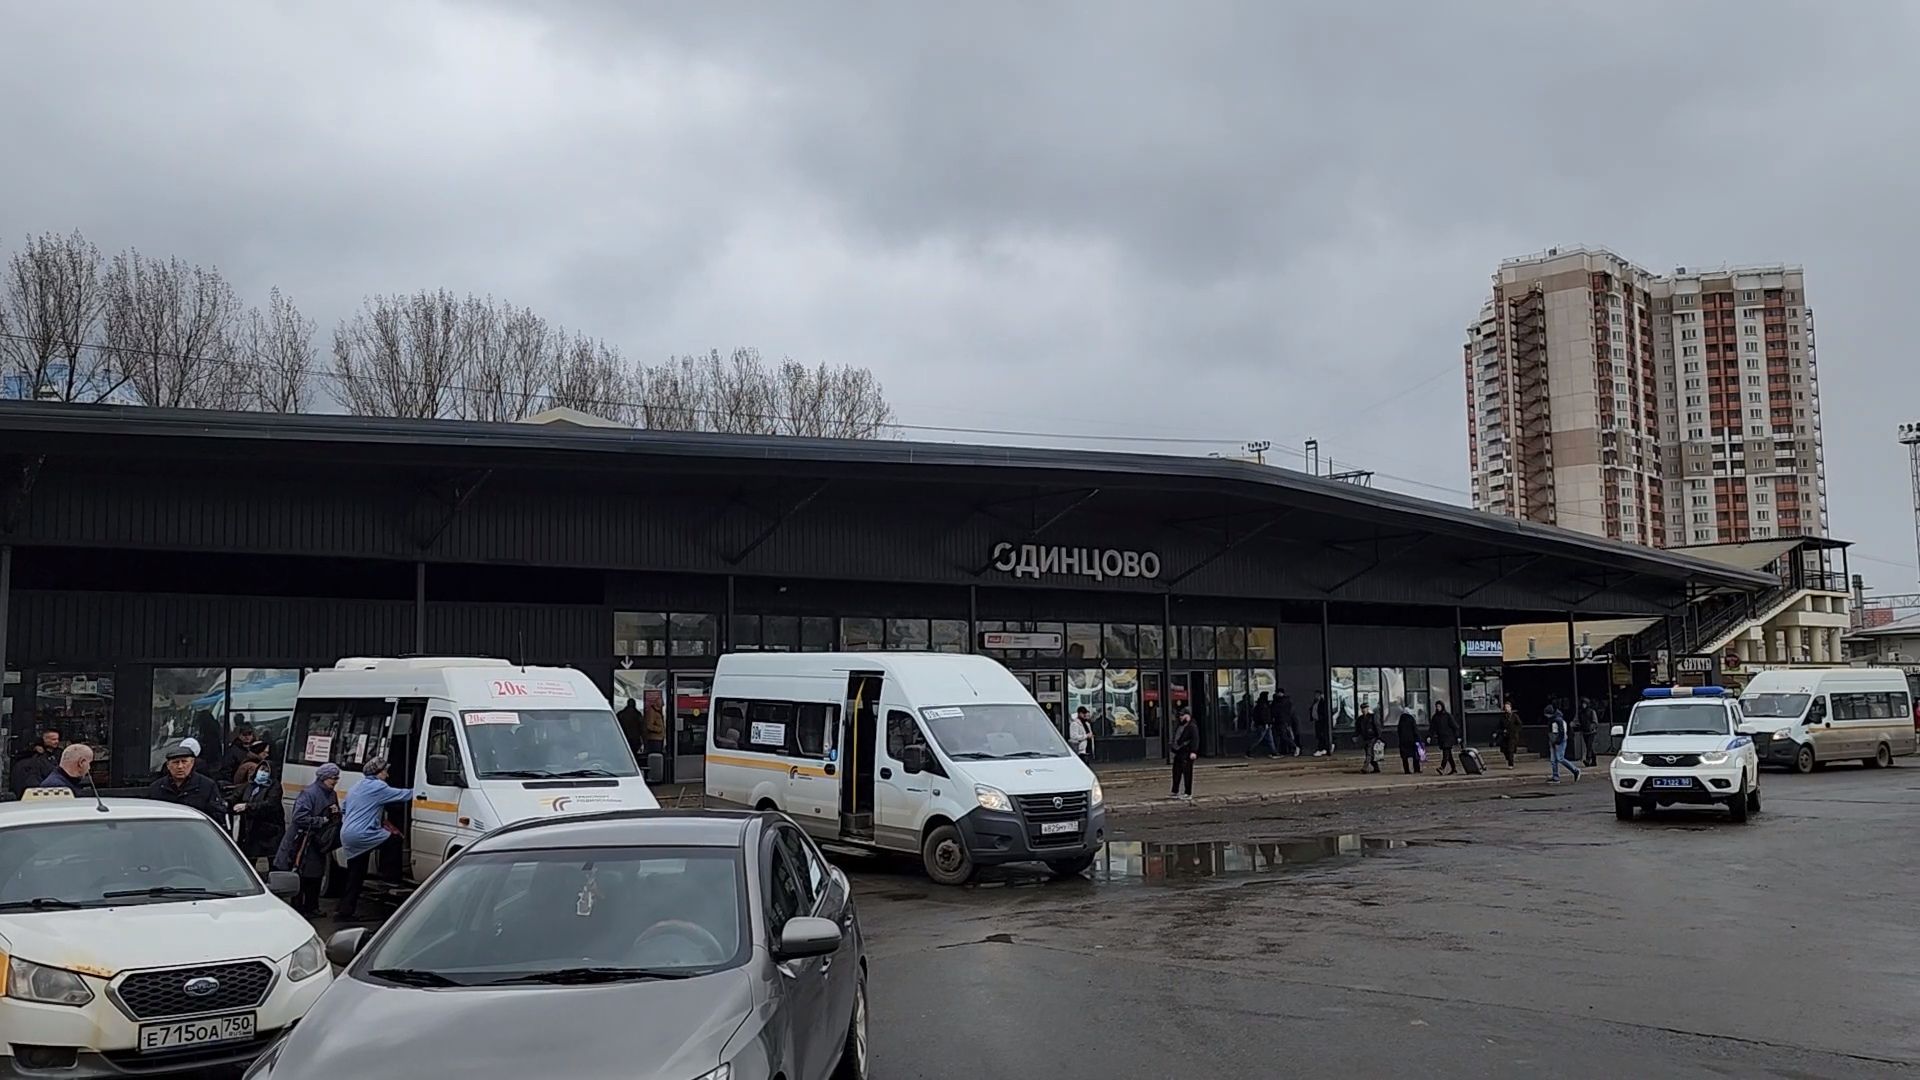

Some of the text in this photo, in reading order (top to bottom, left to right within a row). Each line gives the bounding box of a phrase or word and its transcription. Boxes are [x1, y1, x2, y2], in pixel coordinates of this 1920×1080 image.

[993, 542, 1160, 581] ОДИНЦОВО
[1466, 640, 1502, 650] ШАУРМА
[223, 1017, 250, 1032] 750
